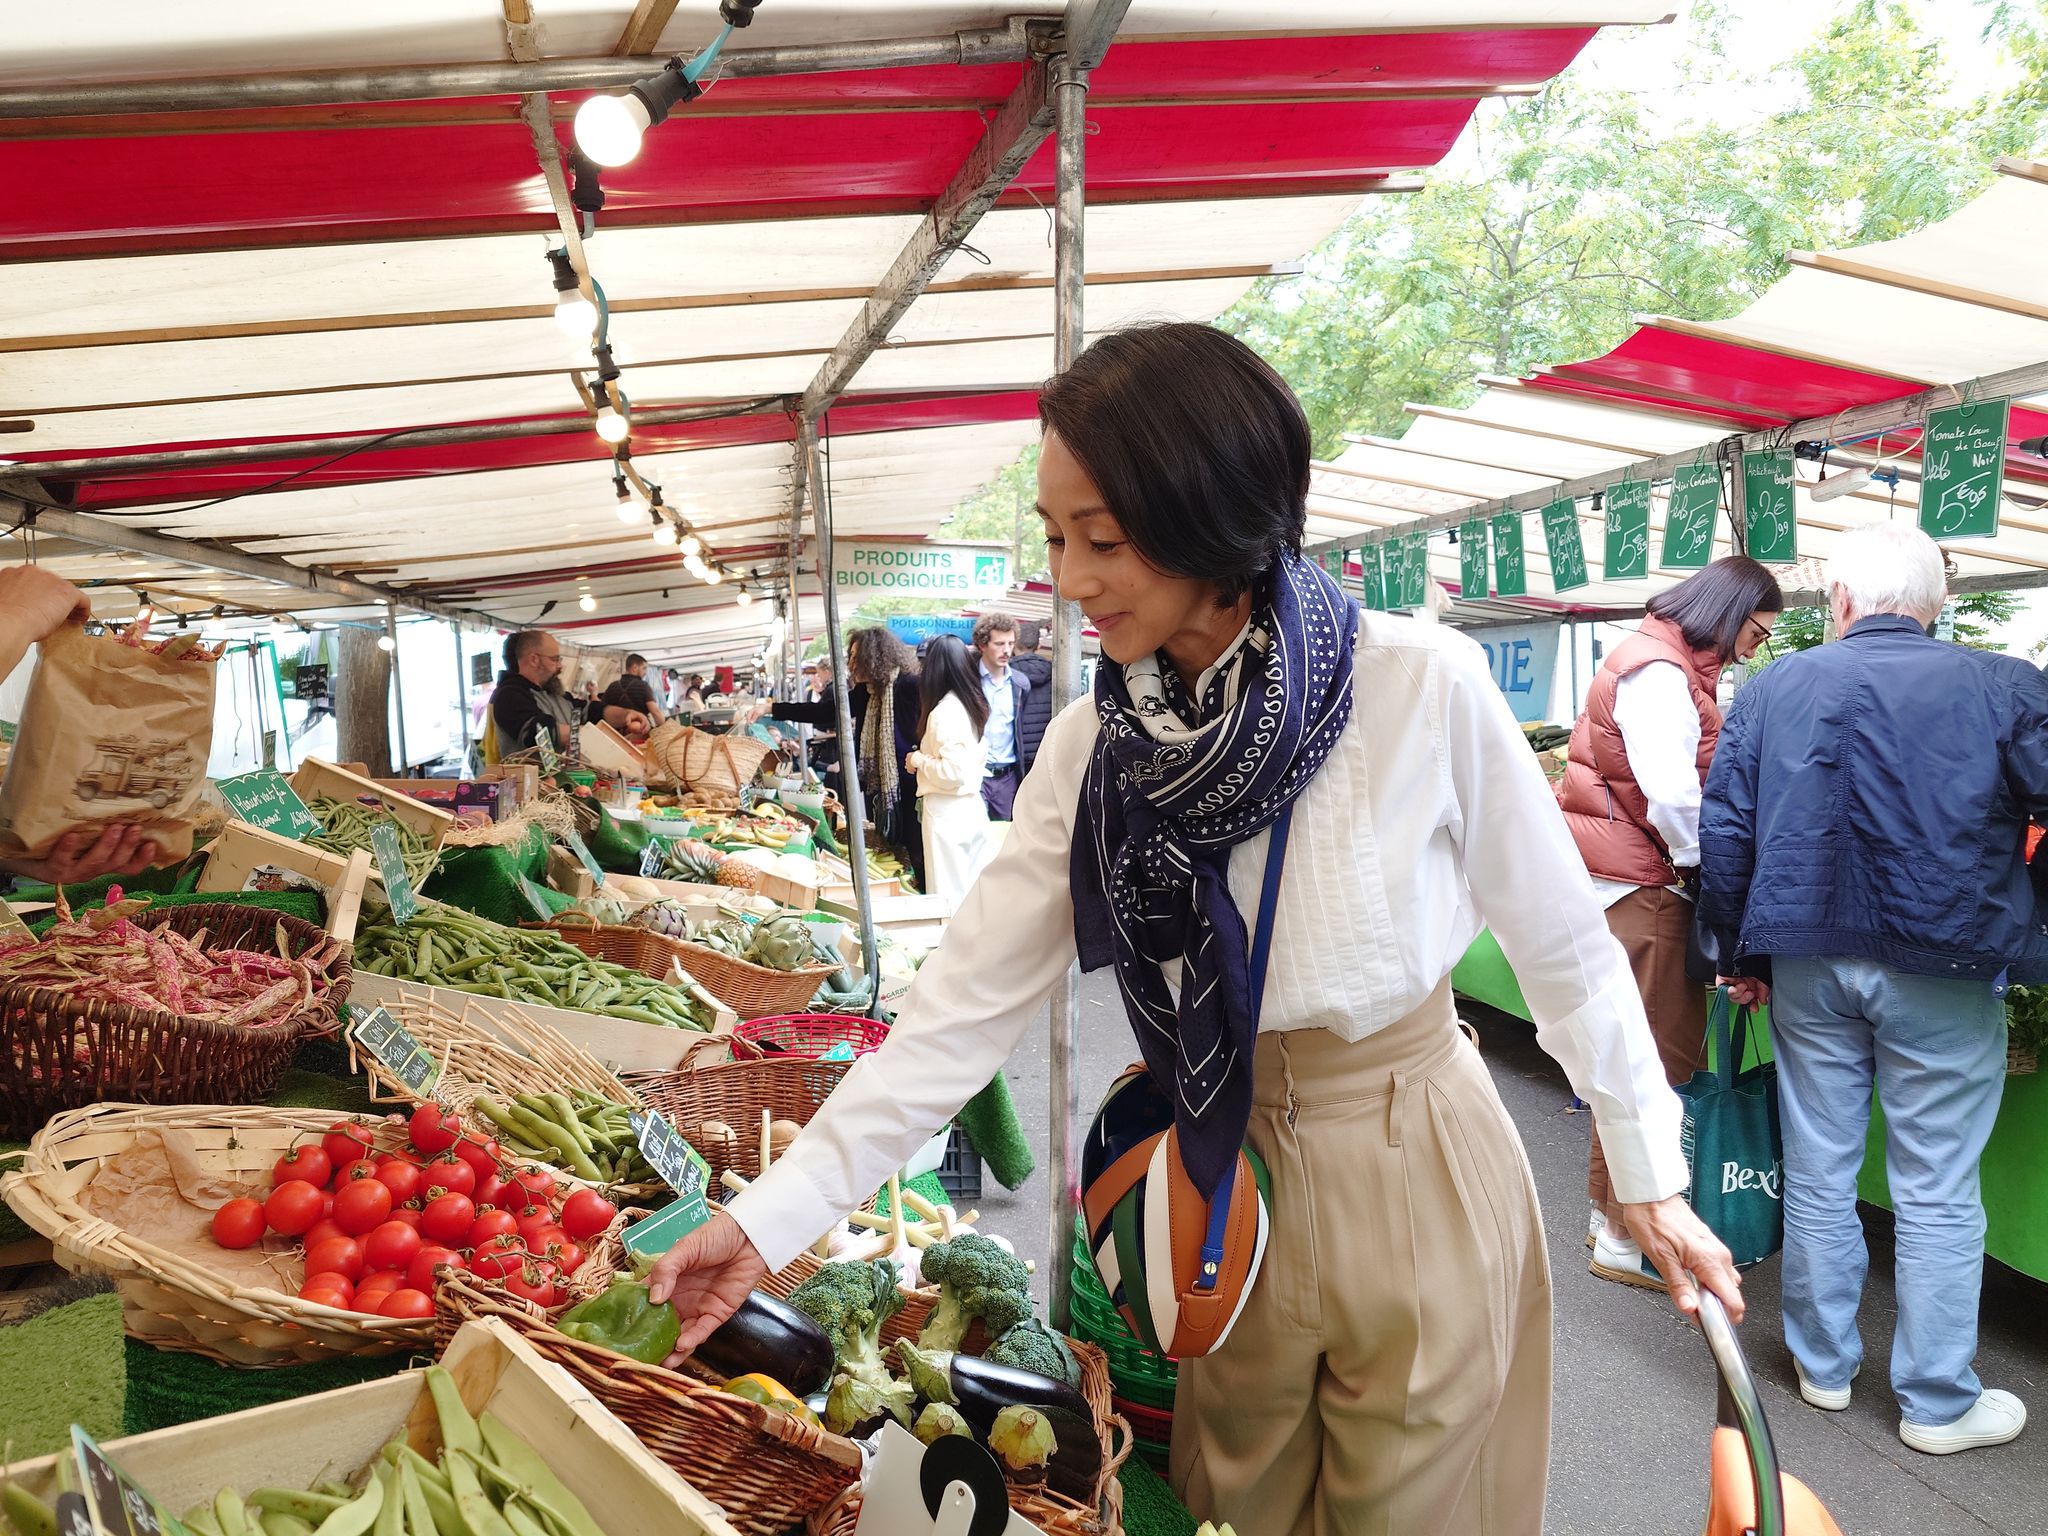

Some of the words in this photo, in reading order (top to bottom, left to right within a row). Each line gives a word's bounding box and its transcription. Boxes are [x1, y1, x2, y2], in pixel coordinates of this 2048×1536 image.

[1929, 421, 1966, 442] Tomate
[1972, 452, 1997, 468] Noir
[853, 550, 952, 568] PRODUITS
[836, 570, 969, 589] BIOLOGIQUES
[1481, 637, 1534, 695] IE
